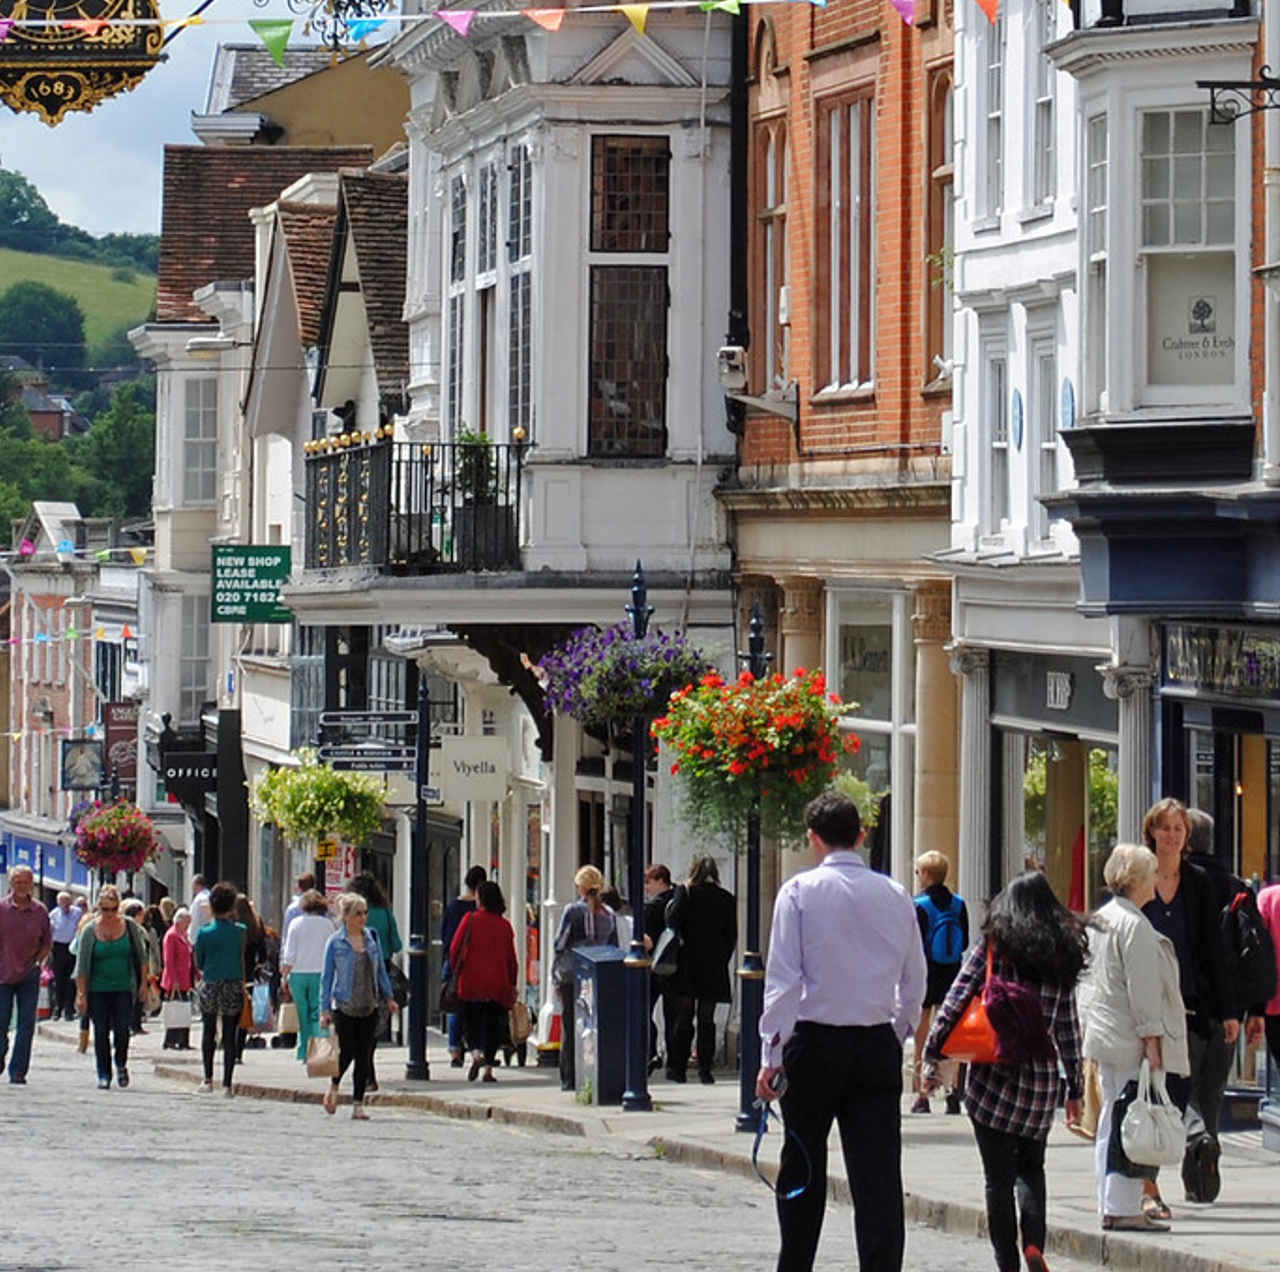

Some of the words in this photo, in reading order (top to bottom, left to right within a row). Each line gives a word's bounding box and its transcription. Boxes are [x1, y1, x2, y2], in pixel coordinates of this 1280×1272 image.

[30, 81, 75, 100] 1683
[216, 556, 245, 567] NEW
[247, 556, 281, 567] SHOP
[216, 568, 257, 578] LEASE
[216, 592, 241, 602] 020
